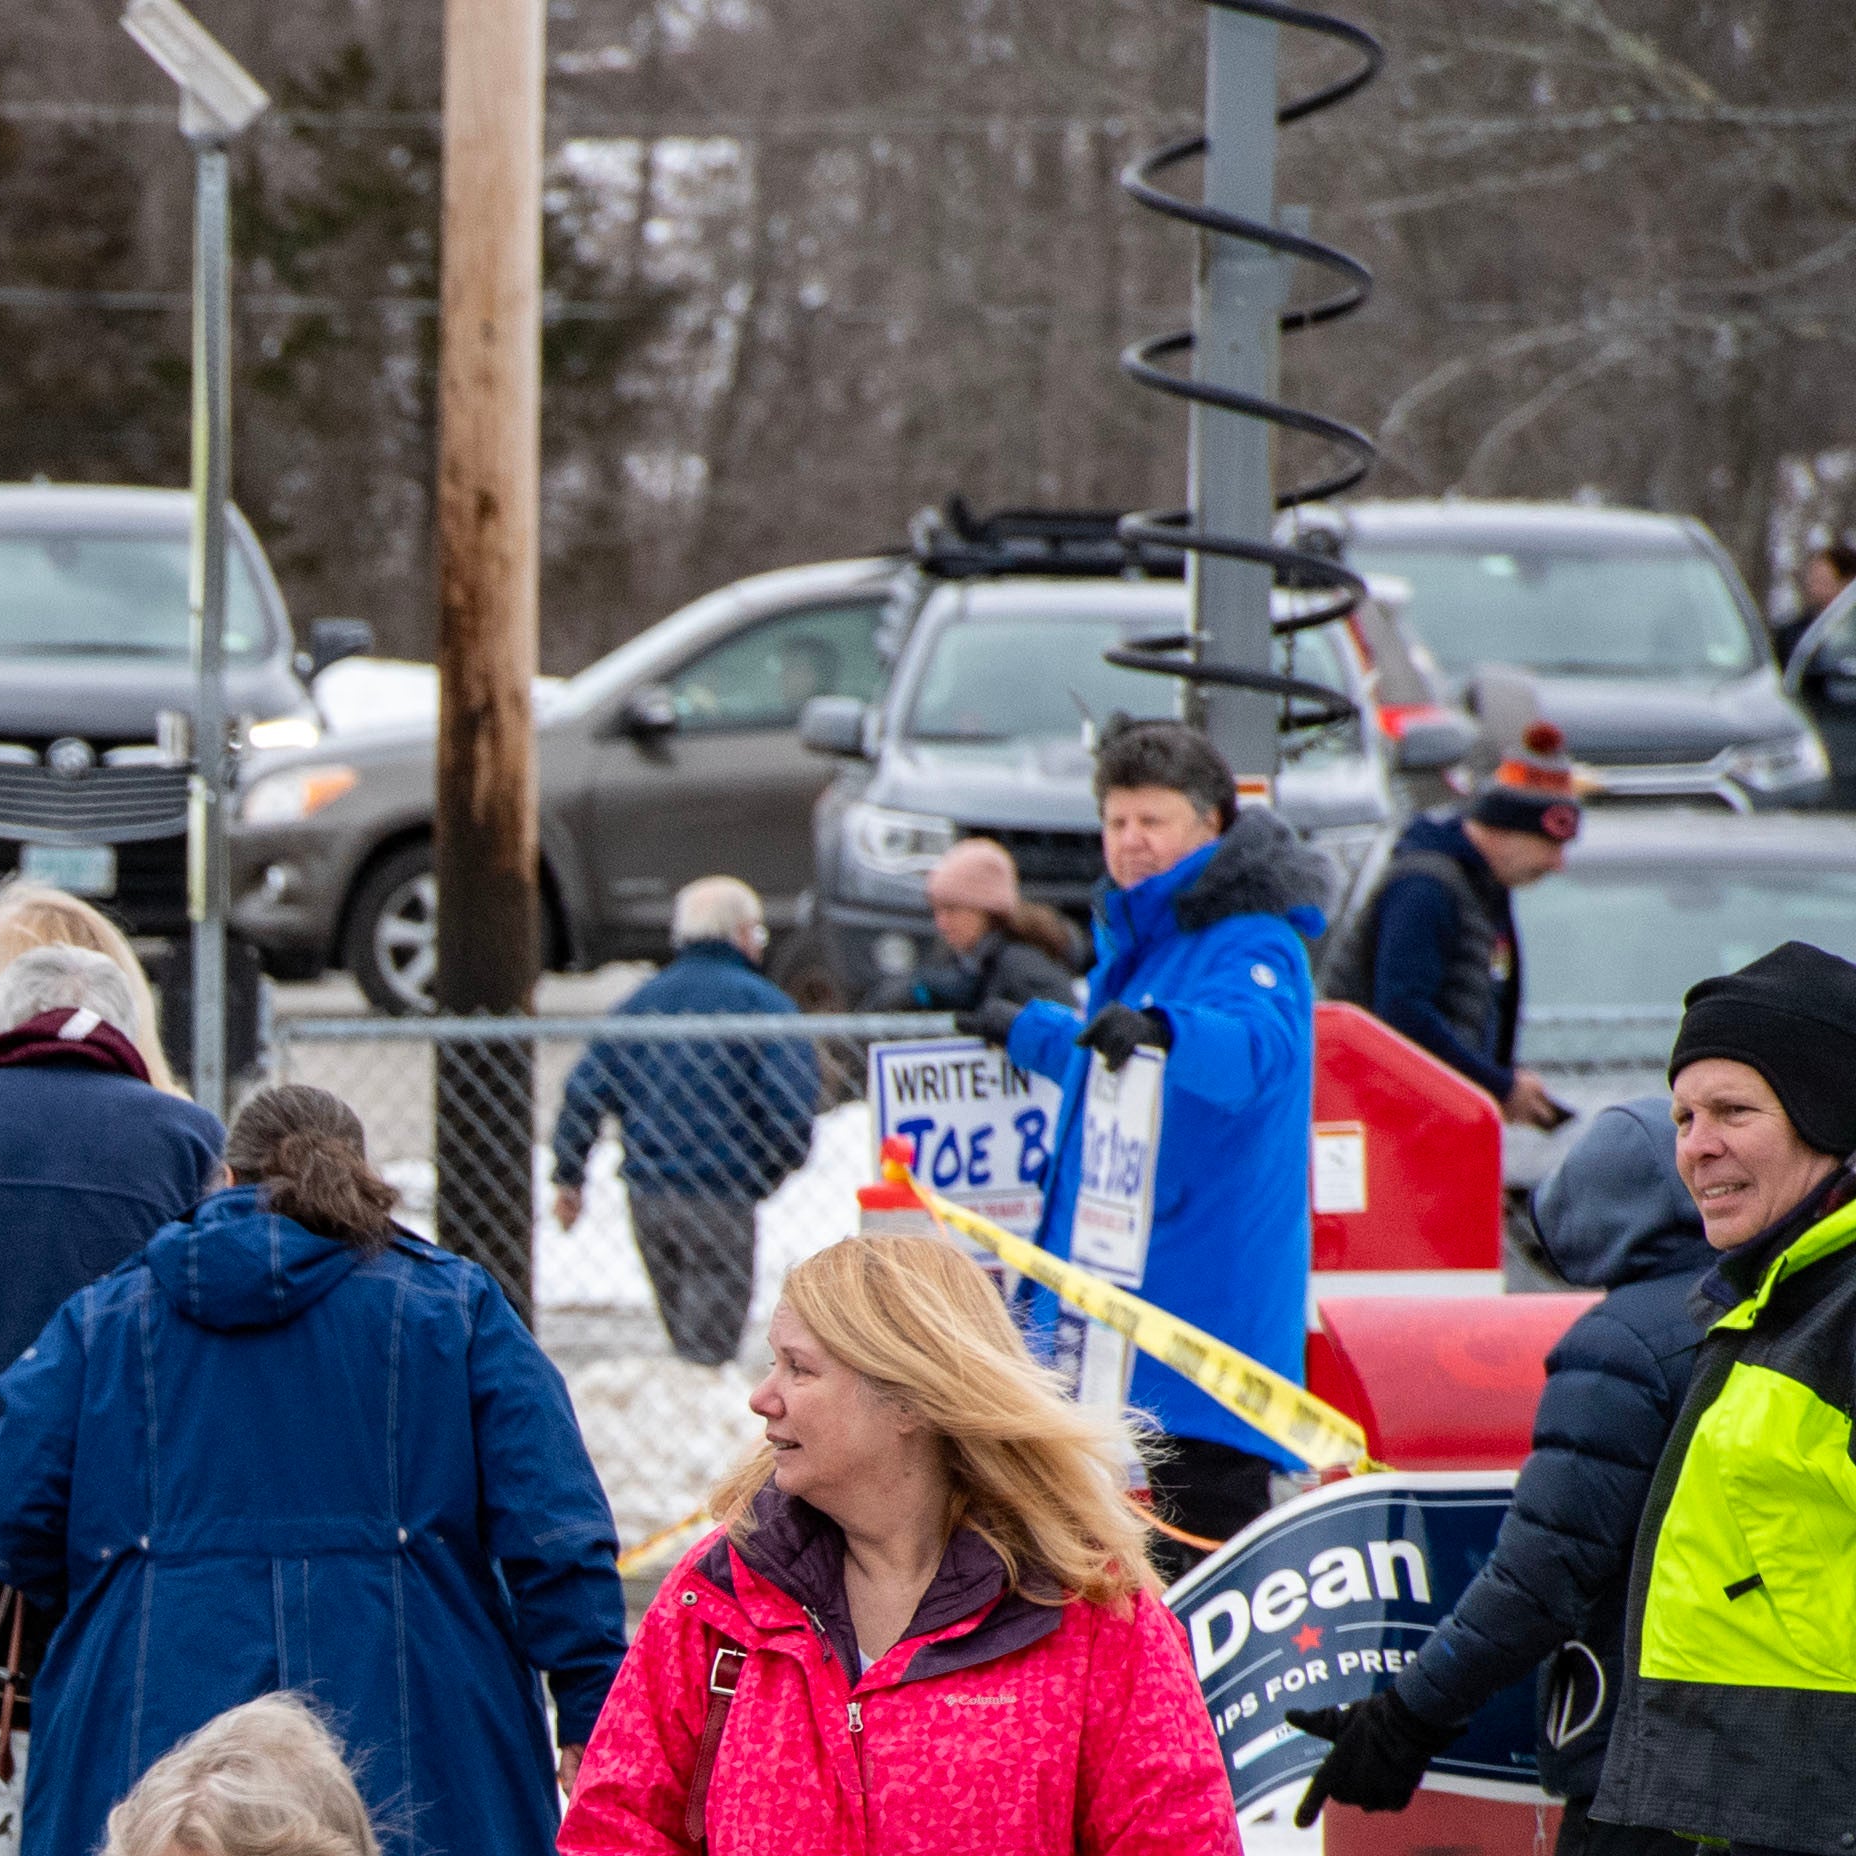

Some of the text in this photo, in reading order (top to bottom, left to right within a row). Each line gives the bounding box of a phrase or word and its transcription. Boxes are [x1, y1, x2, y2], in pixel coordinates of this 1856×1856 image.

[892, 1060, 1031, 1104] WRITE-IN
[897, 1116, 994, 1188] JOE
[1014, 1106, 1050, 1184] B
[1189, 1539, 1432, 1682] Dean
[957, 1694, 1017, 1706] Columbia
[1265, 1657, 1329, 1703] FOR
